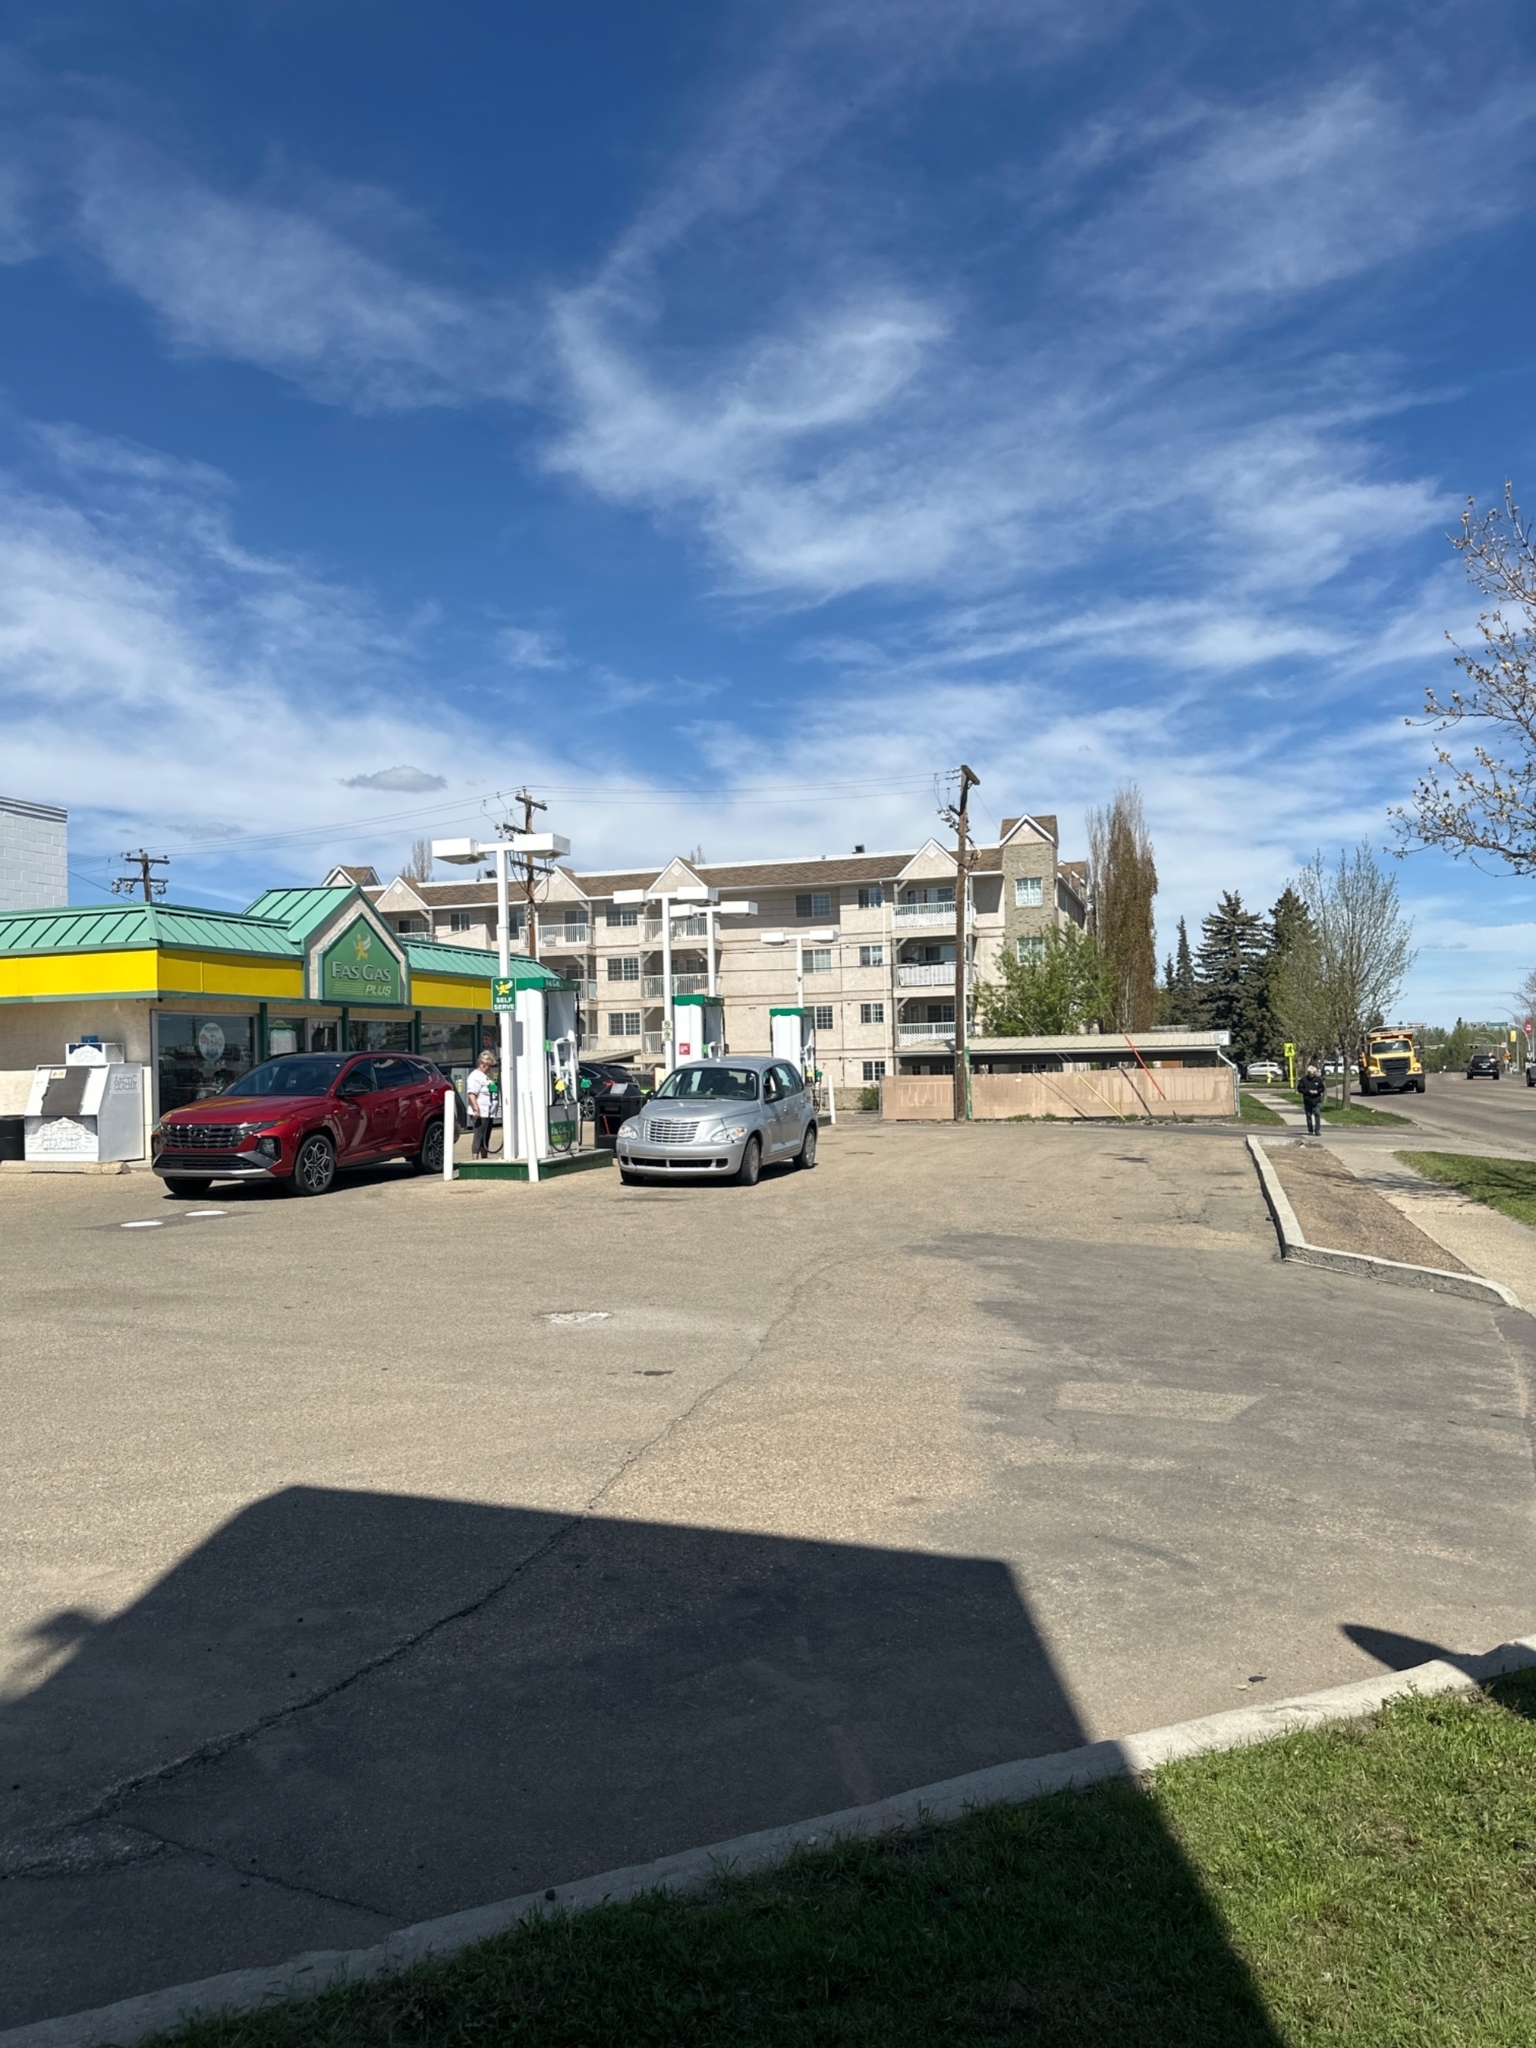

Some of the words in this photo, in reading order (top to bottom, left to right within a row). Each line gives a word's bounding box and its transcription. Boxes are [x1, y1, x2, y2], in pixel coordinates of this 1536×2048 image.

[331, 961, 360, 979] FAS
[362, 964, 392, 982] GAS
[365, 984, 392, 996] PLUS
